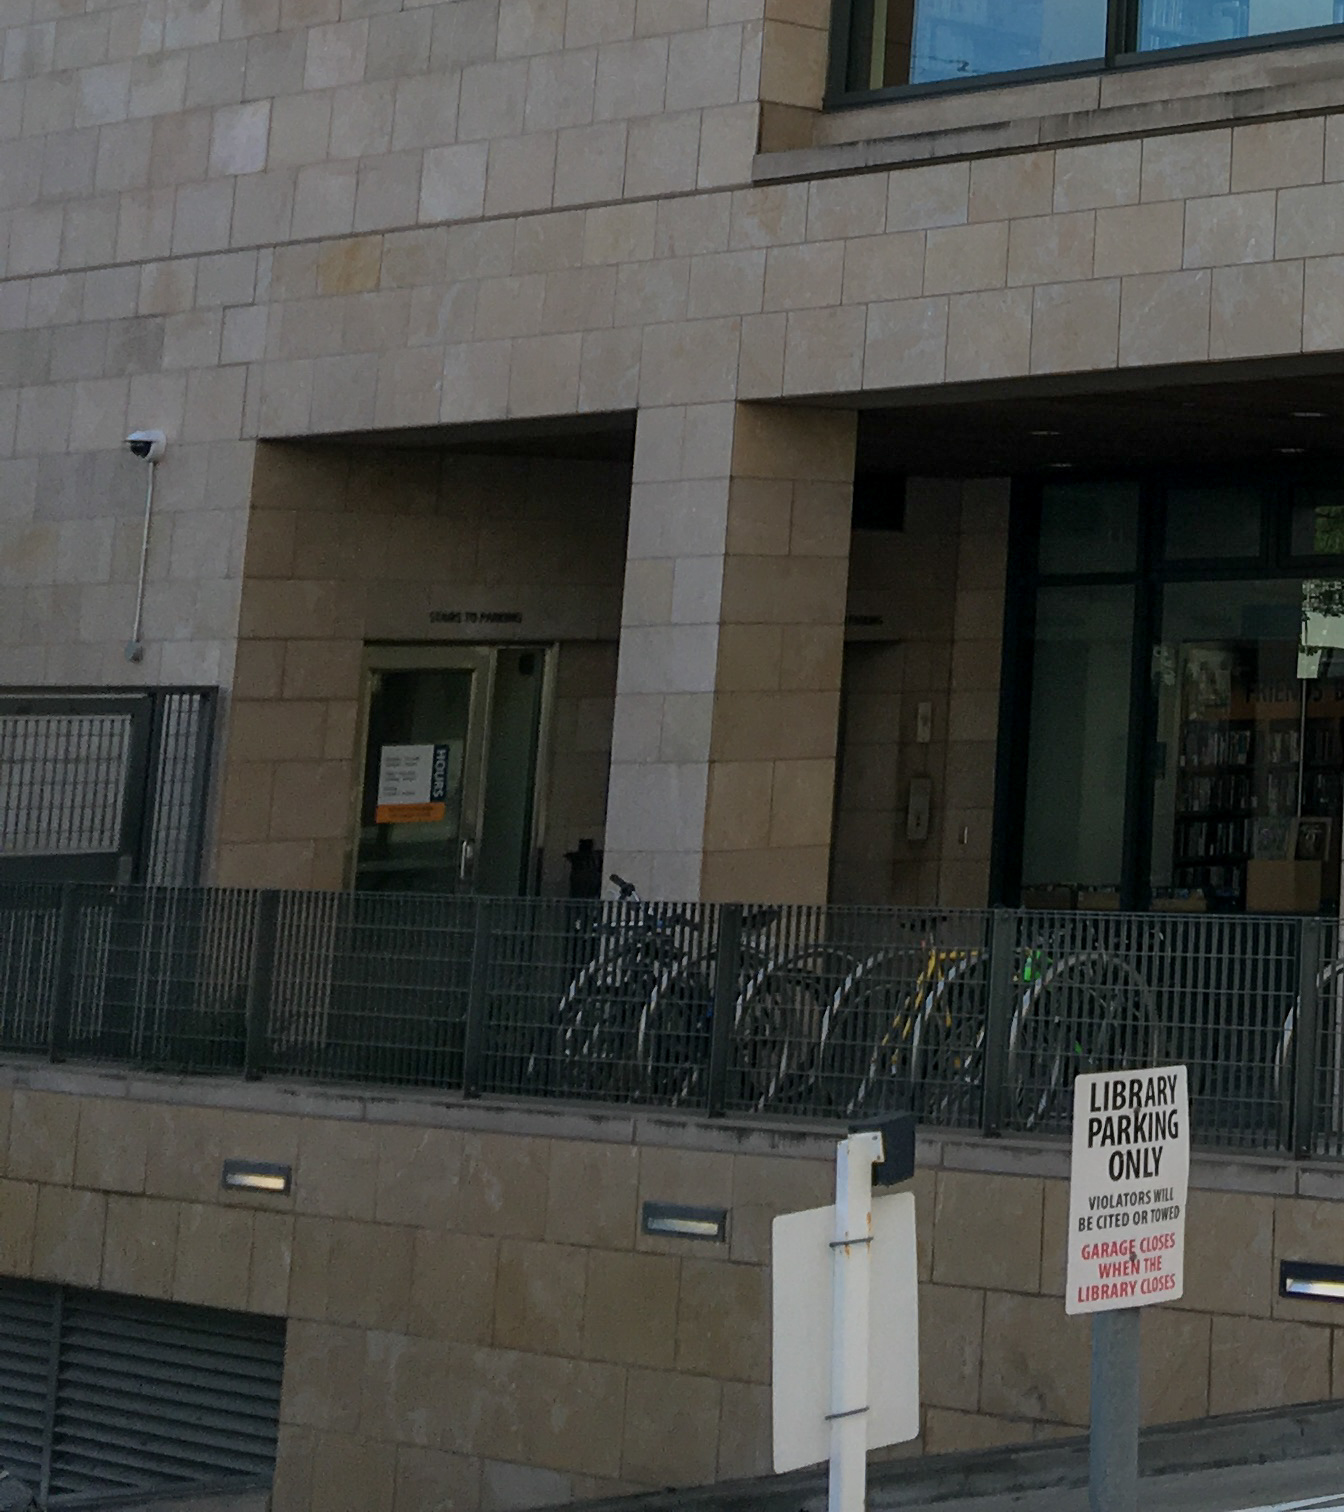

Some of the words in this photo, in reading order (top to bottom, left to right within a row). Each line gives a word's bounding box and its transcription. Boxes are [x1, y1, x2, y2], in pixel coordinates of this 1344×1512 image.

[432, 748, 447, 798] HOURS
[1089, 1073, 1178, 1114] LIBRARY
[1087, 1109, 1179, 1148] PARKING
[1108, 1145, 1164, 1182] ONLY
[1088, 1189, 1152, 1211] VIOLATORS
[1153, 1186, 1175, 1203] WILL
[1078, 1215, 1093, 1232] BE
[1096, 1211, 1129, 1231] CITED
[1133, 1209, 1148, 1226] OR
[1150, 1204, 1180, 1224] TOWED
[1081, 1239, 1136, 1261] GARAGE
[1139, 1232, 1176, 1255] CLOSES
[1097, 1258, 1141, 1280] WHEN
[1143, 1255, 1163, 1273] THE
[1077, 1281, 1138, 1304] LIBRARY
[1139, 1273, 1176, 1295] CLOSES
